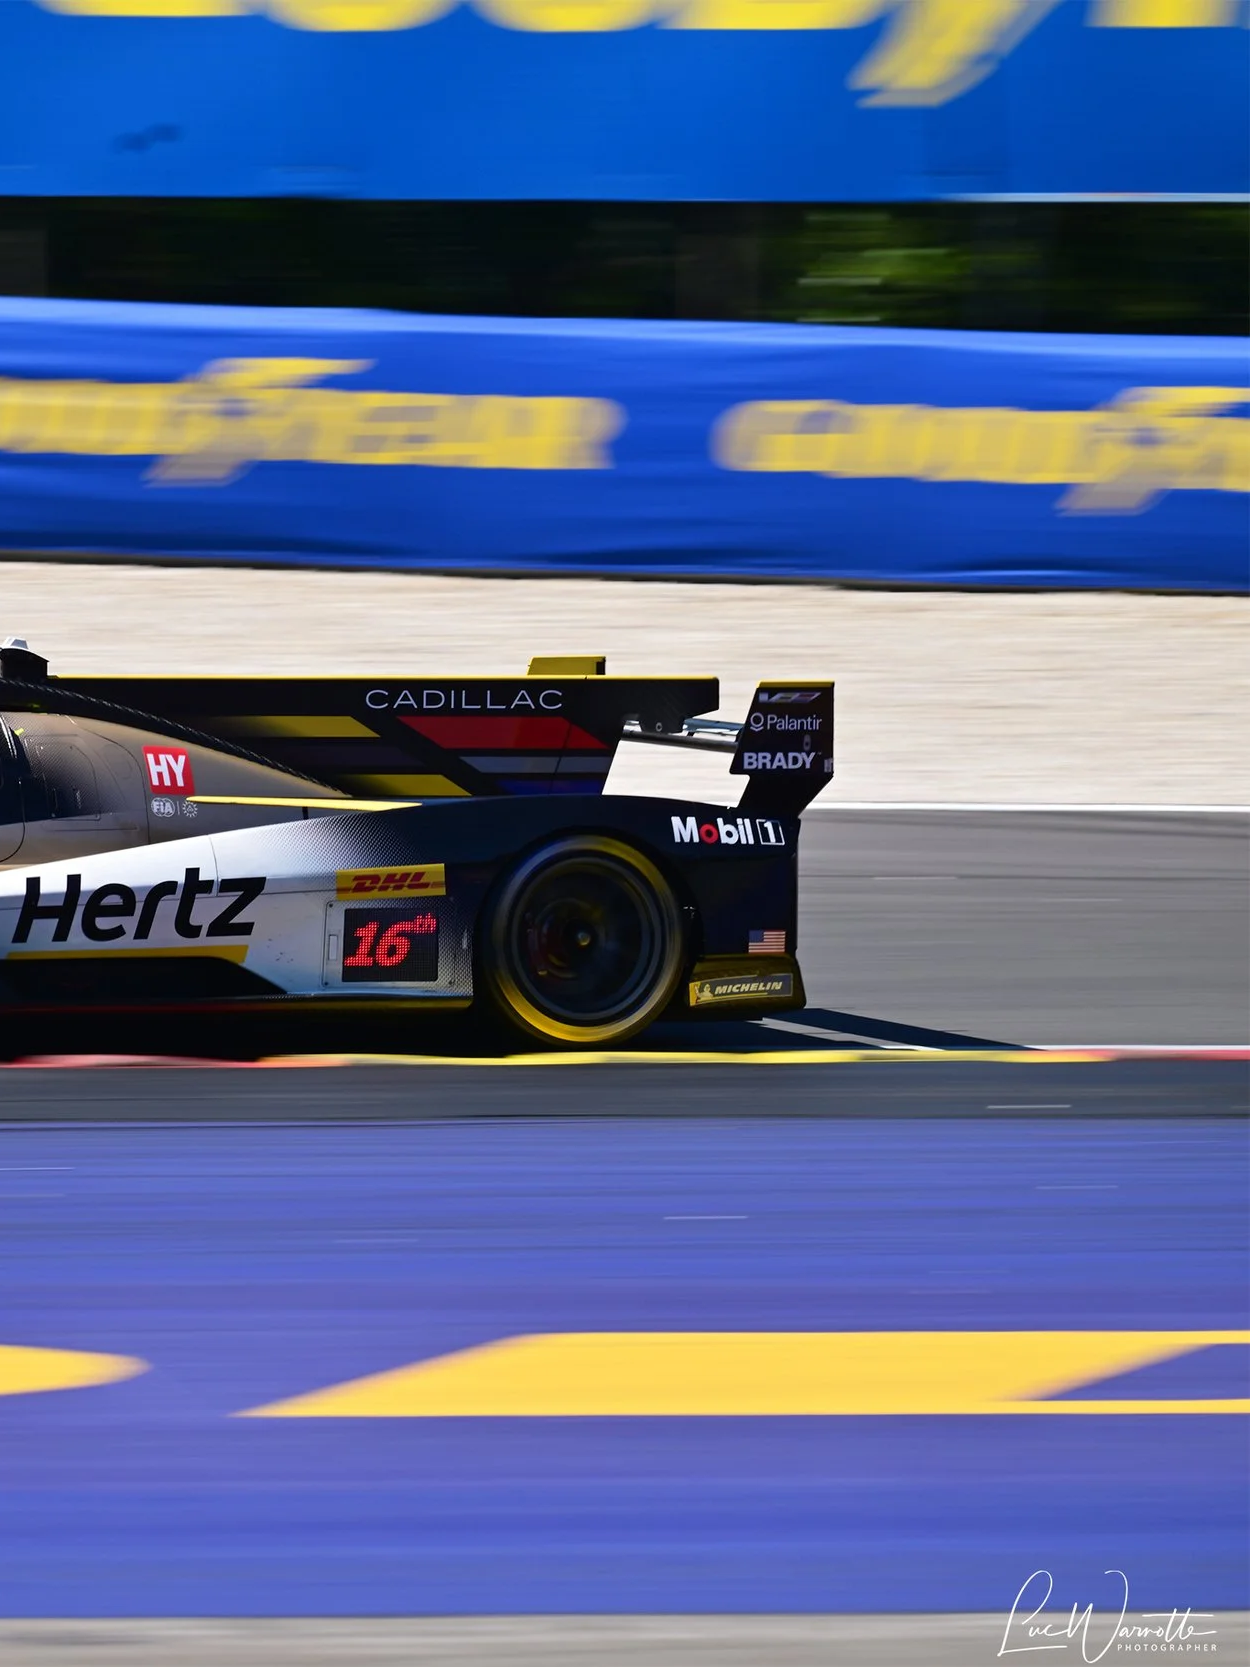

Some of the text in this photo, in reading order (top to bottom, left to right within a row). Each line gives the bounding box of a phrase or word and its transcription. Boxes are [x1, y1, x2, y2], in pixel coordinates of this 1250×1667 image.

[364, 688, 563, 711] CADILLAC
[766, 714, 823, 731] Palantir
[146, 752, 186, 788] HY
[742, 751, 816, 770] BRADY
[670, 815, 755, 845] Mobil
[351, 871, 431, 893] DHL
[10, 866, 267, 944] Hertz
[714, 980, 784, 996] MICHELIN
